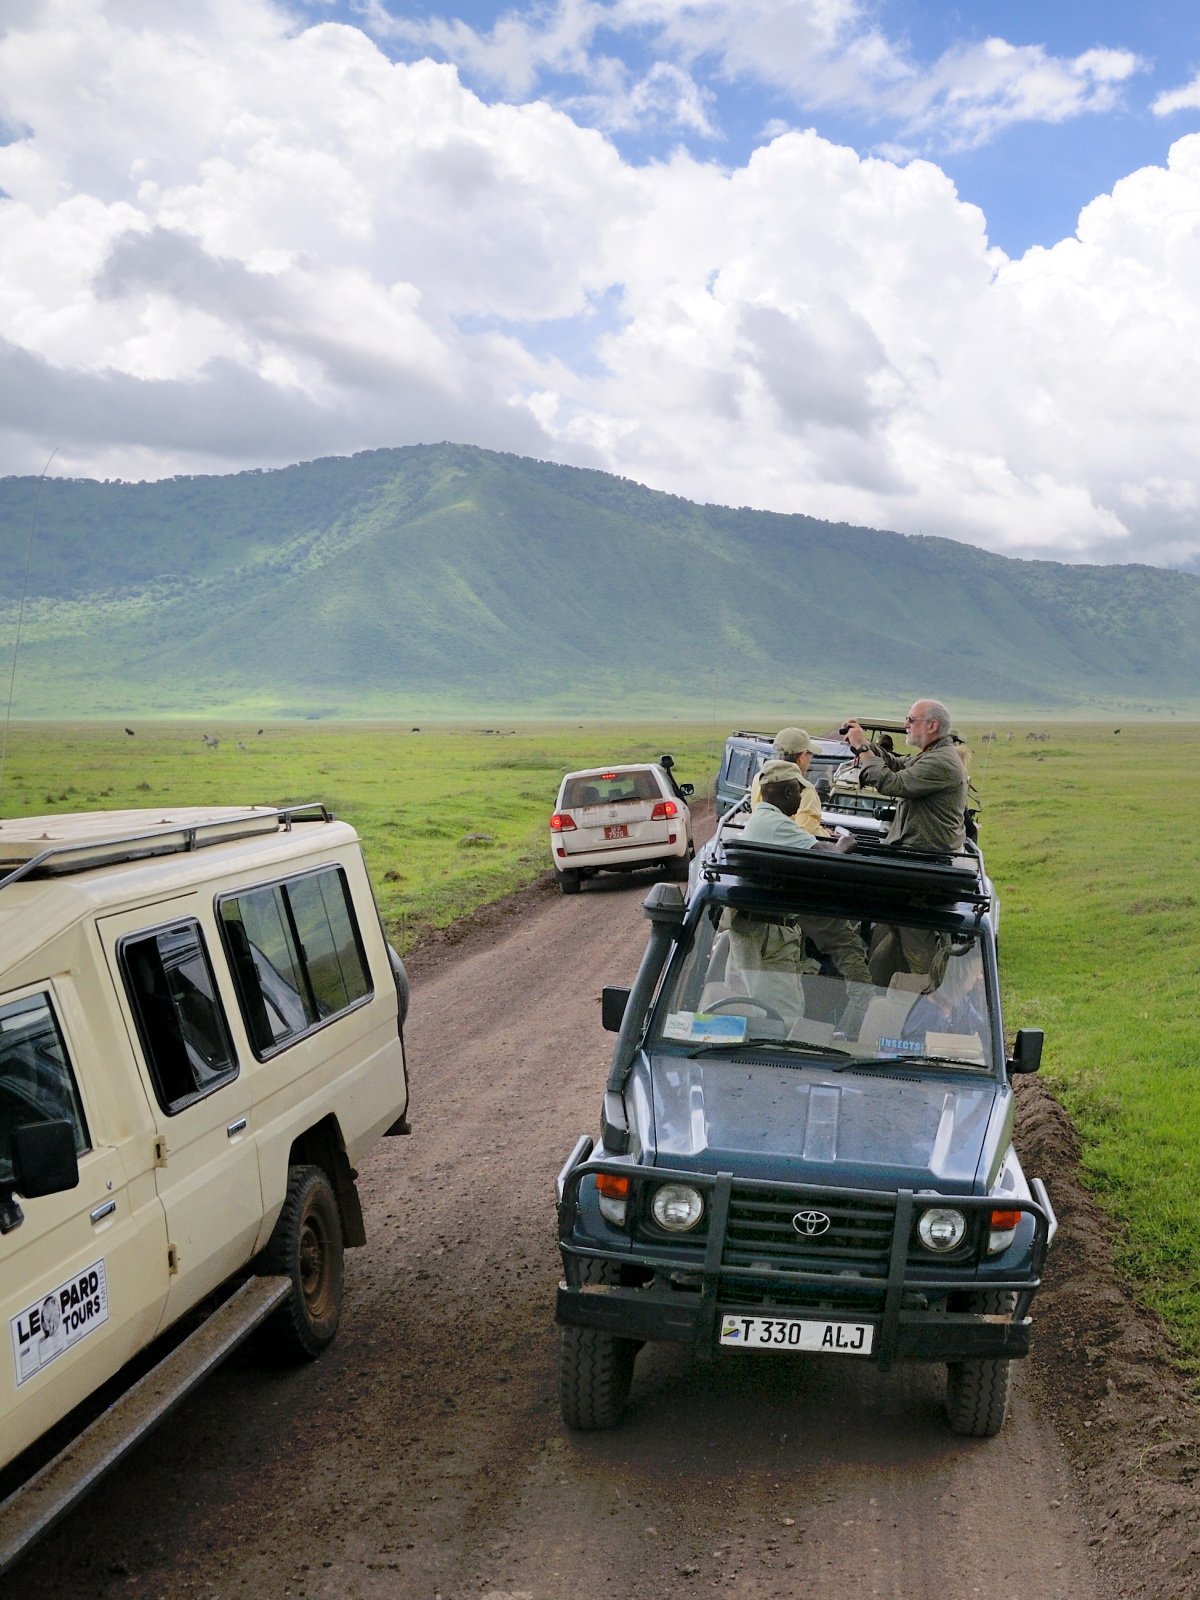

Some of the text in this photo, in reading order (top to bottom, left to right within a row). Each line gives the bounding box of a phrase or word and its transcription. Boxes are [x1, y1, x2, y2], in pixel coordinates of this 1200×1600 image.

[881, 1037, 921, 1051] INSECTS
[62, 1295, 101, 1335] TOURS
[741, 1319, 865, 1349] T 330 ALJ
